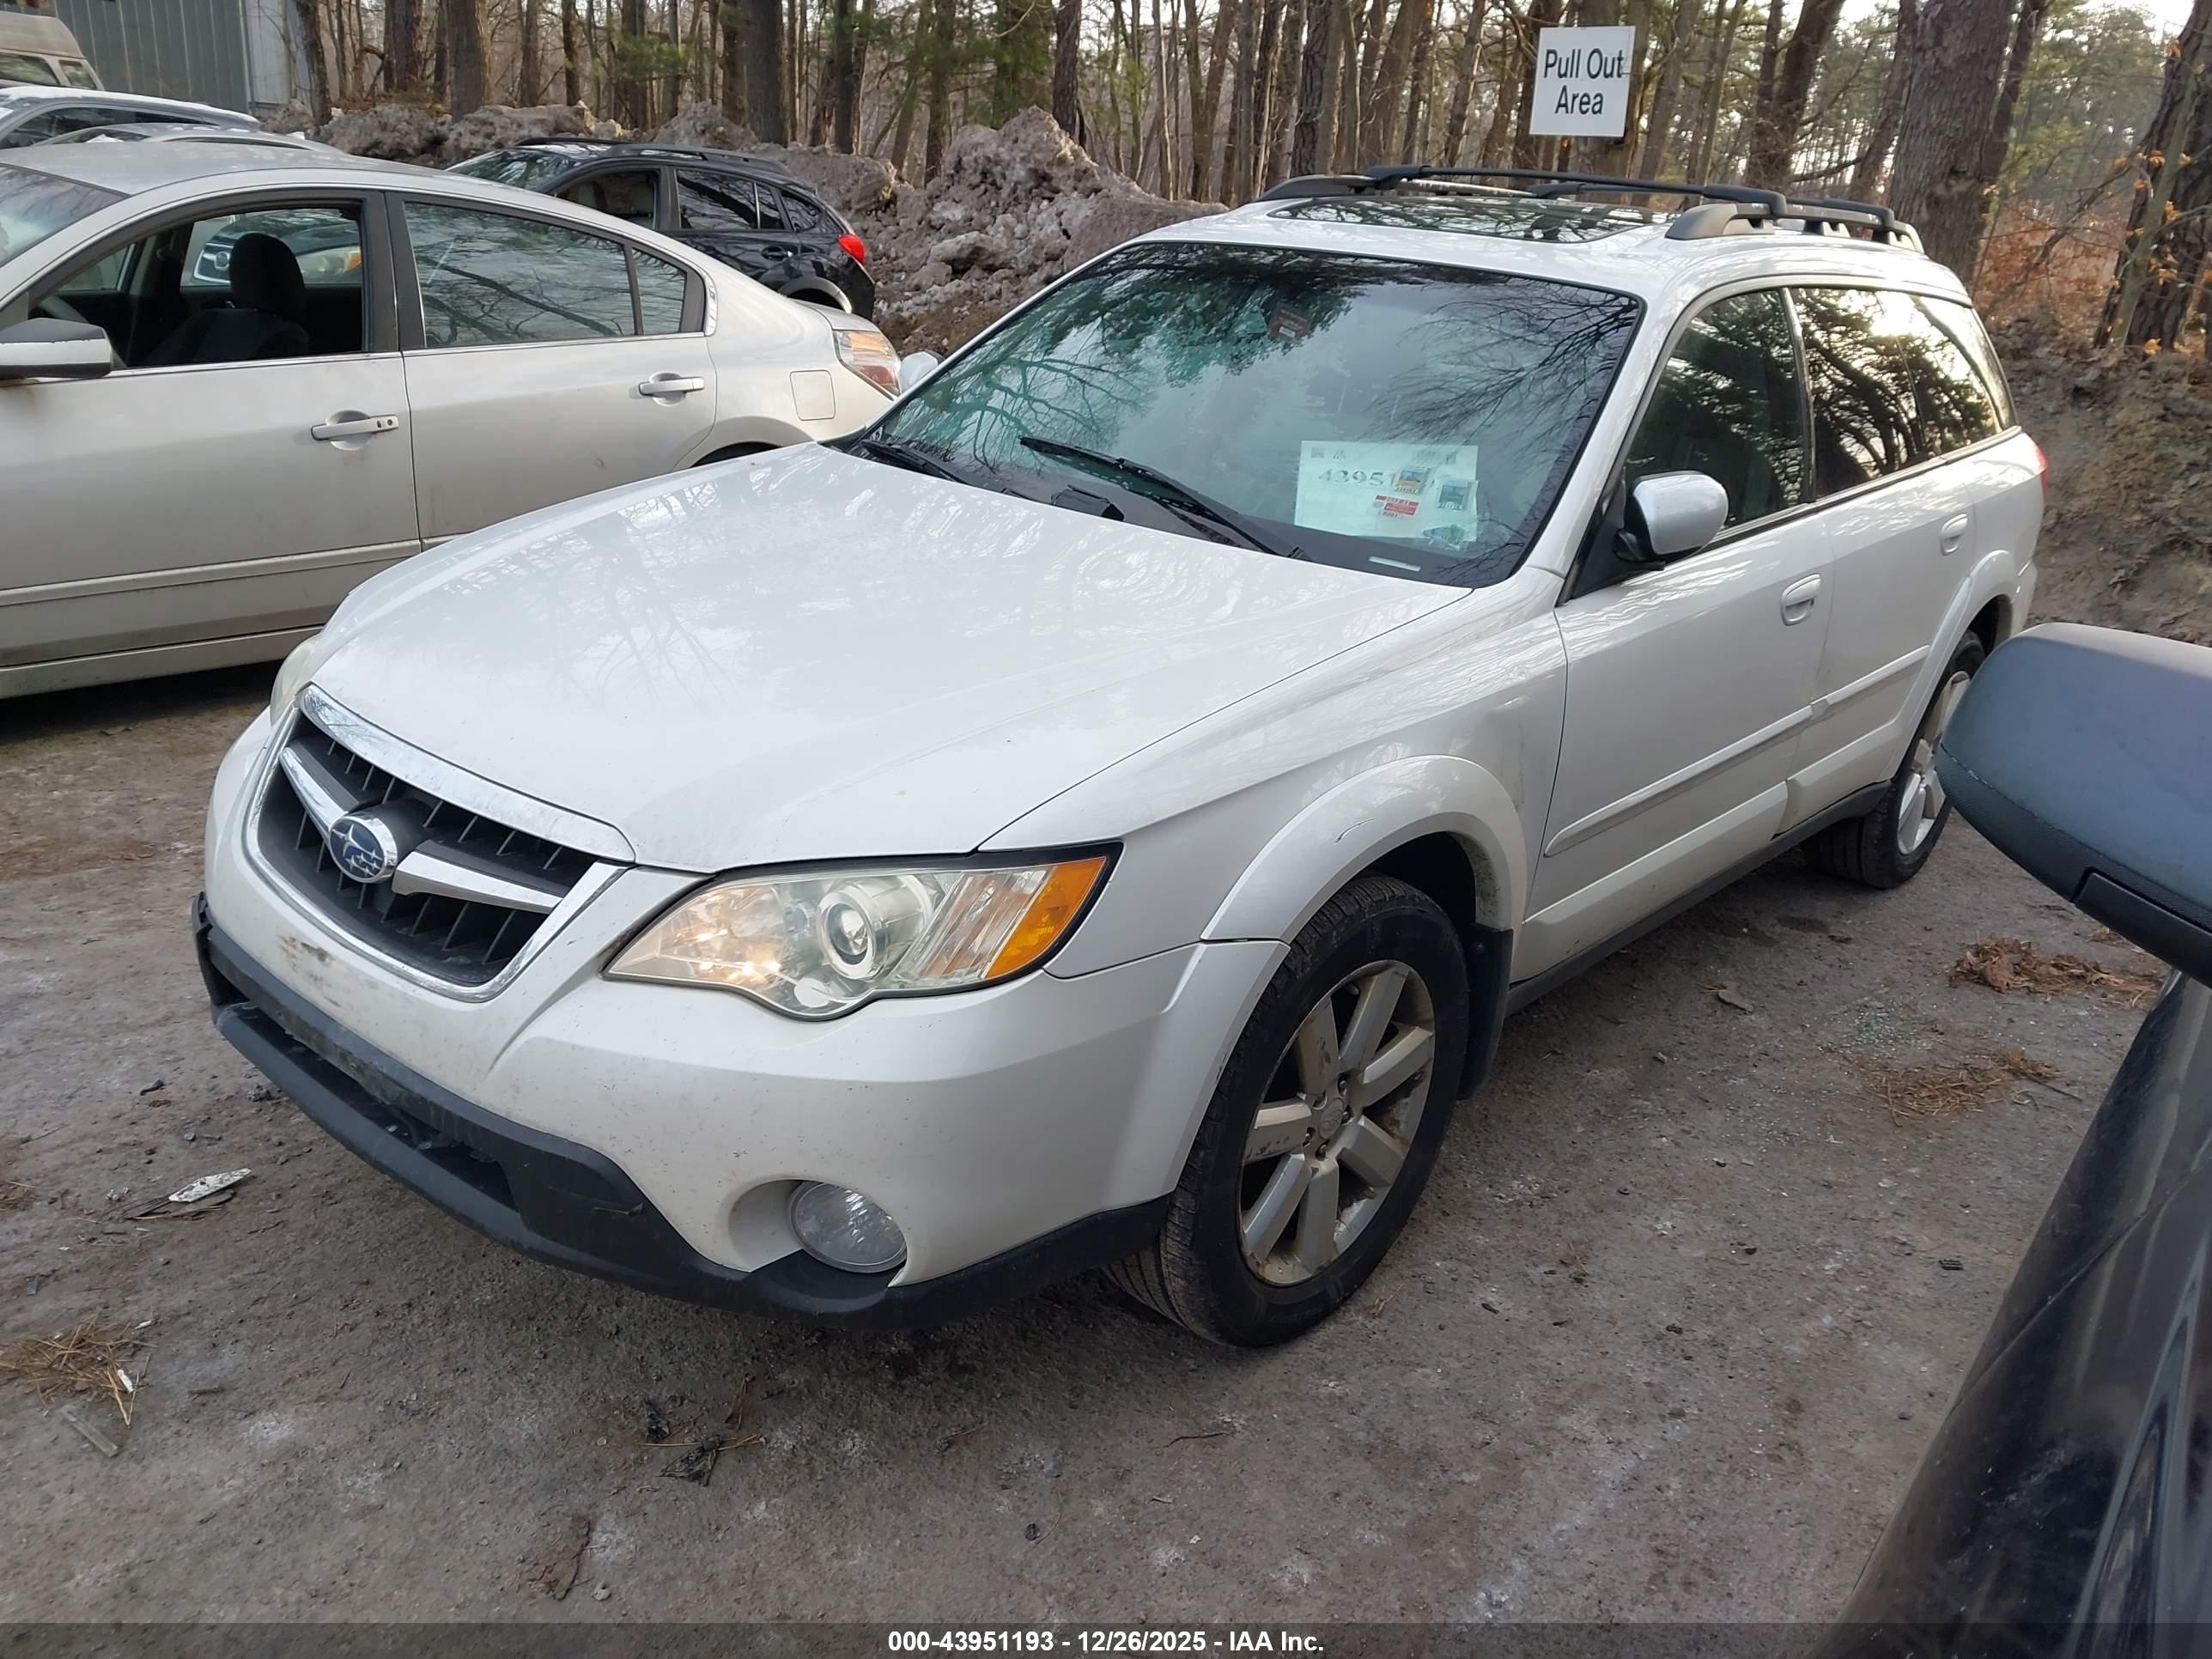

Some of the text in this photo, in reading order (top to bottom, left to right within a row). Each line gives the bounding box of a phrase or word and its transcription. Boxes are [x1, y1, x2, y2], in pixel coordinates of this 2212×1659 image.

[1544, 47, 1624, 80] Pull Out
[1554, 84, 1604, 115] Area
